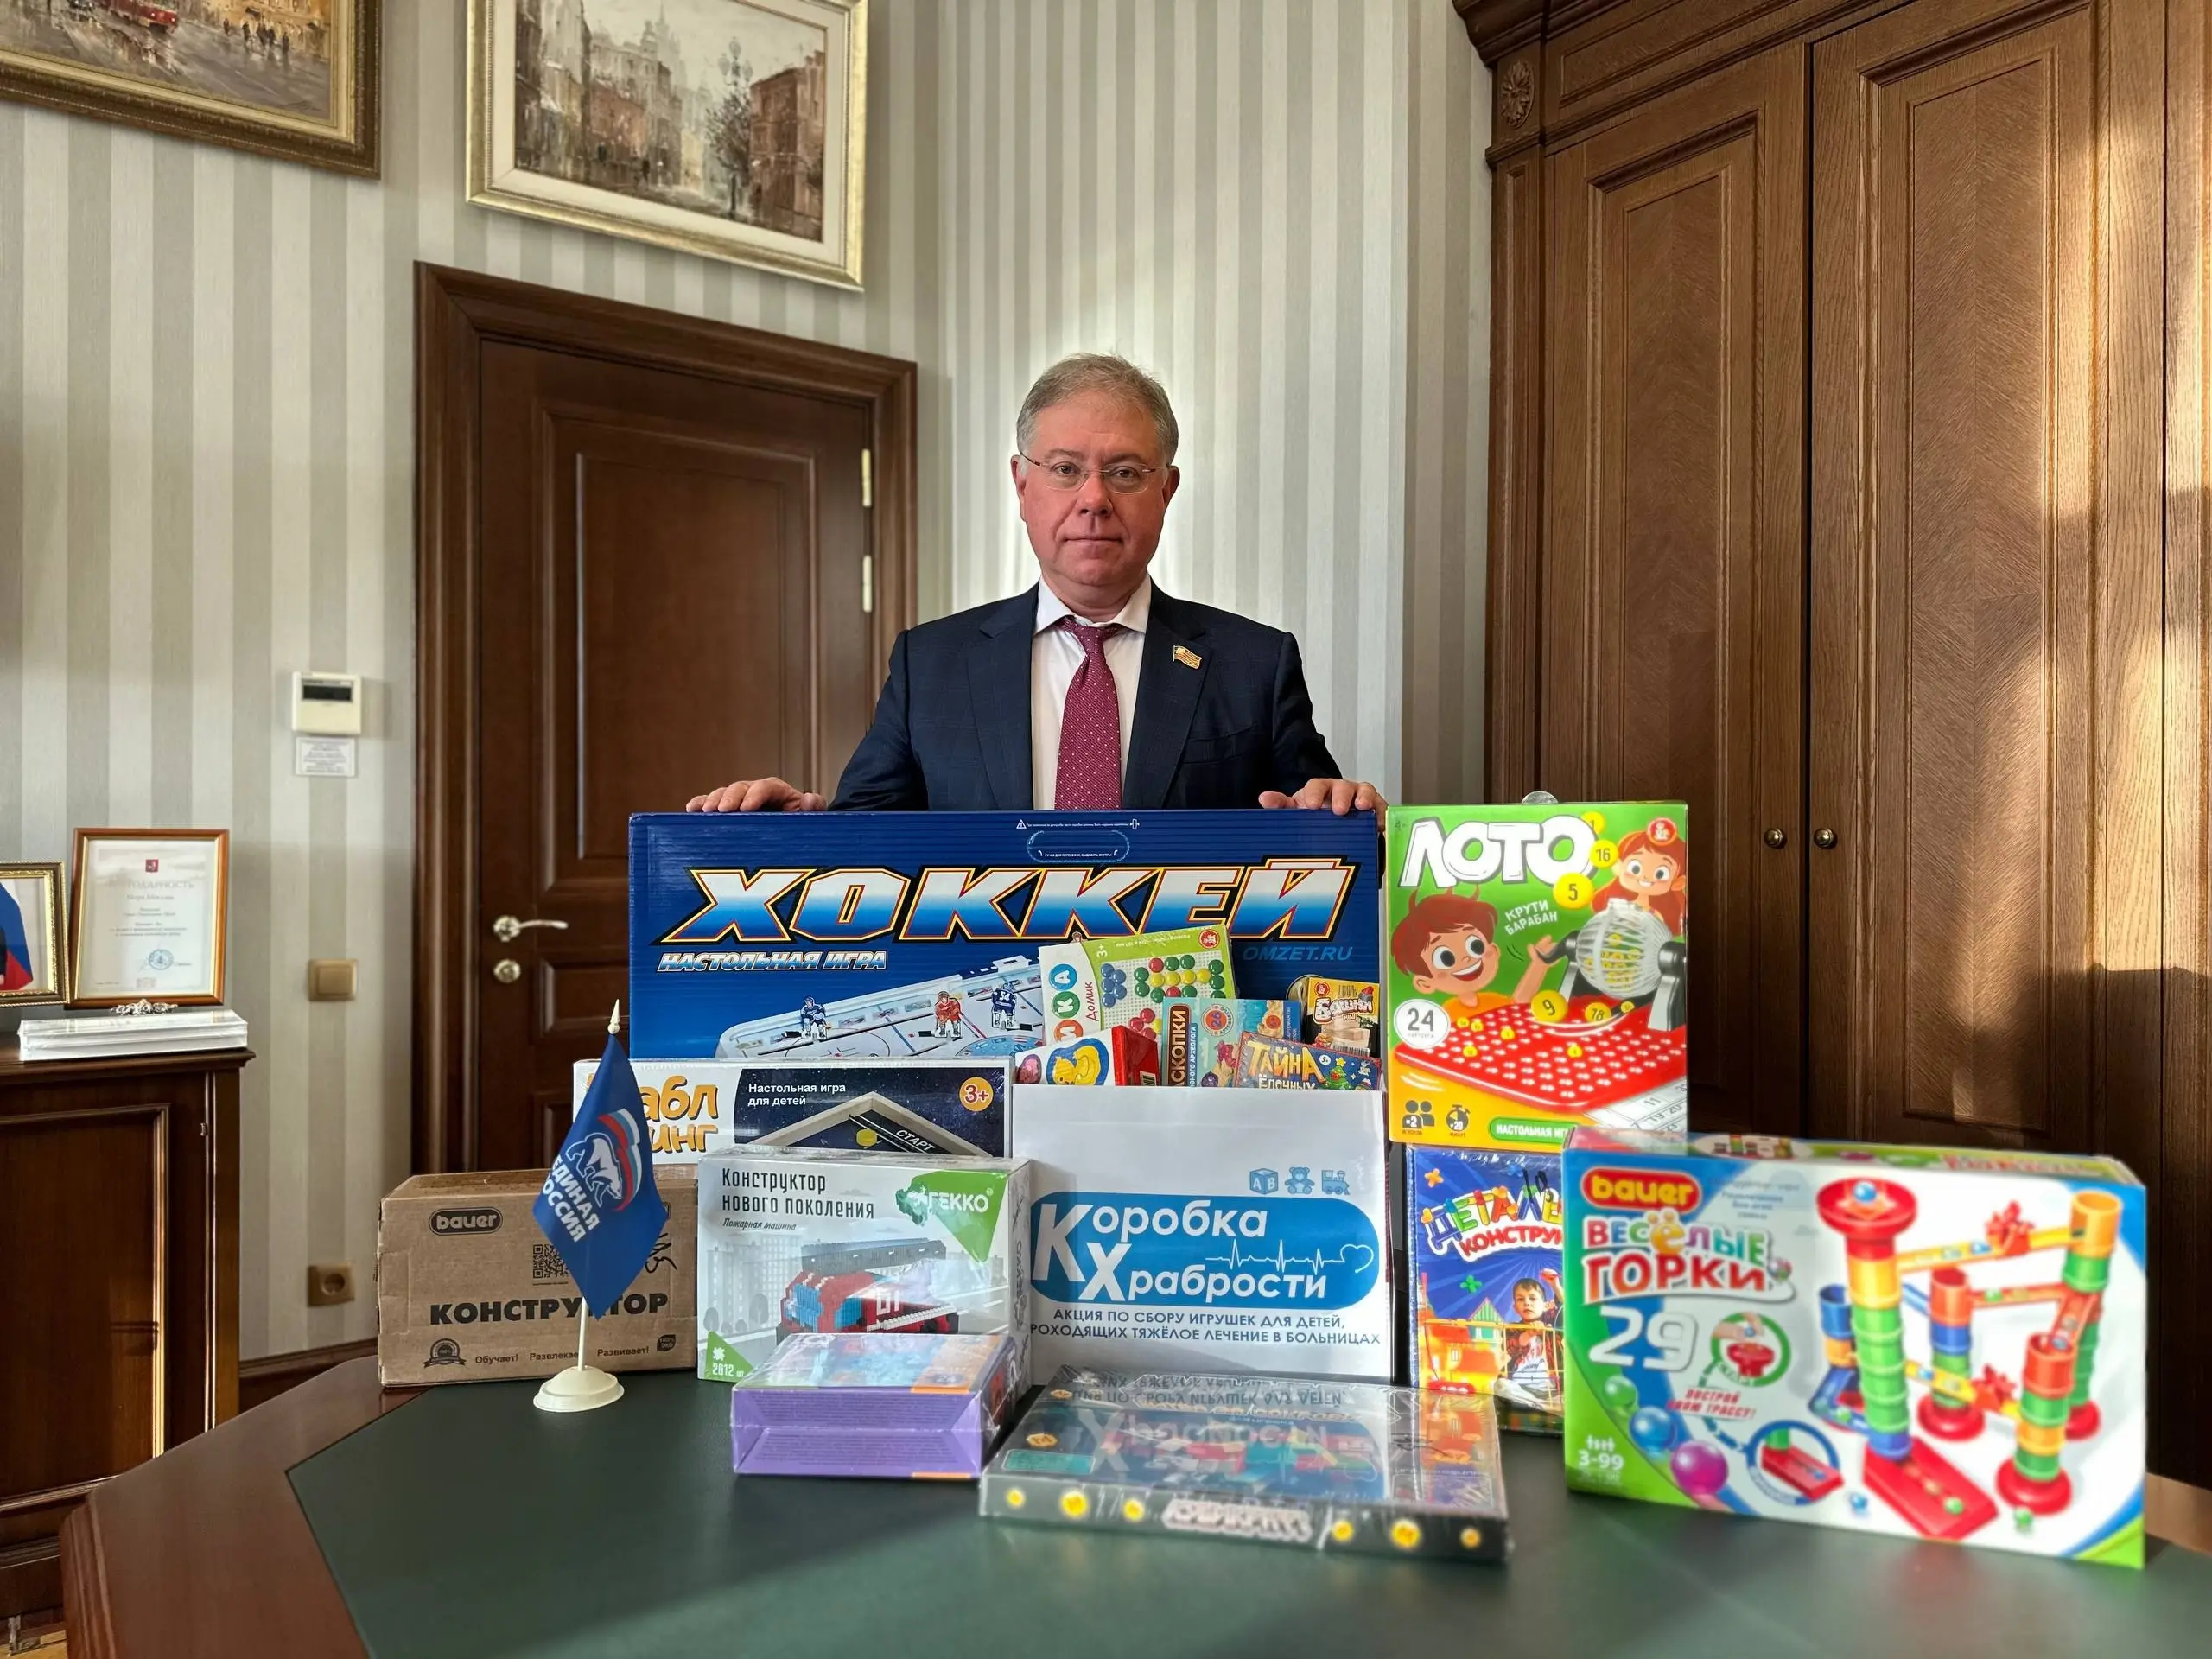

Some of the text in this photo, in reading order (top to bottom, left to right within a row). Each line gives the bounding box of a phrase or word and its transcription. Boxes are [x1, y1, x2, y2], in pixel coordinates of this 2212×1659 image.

[1398, 815, 1598, 888] ЛОТО
[1596, 848, 1611, 862] 16
[659, 857, 1357, 944] ХОККЕЙ
[1567, 883, 1578, 901] 5
[1504, 899, 1549, 922] КРУТИ
[1504, 910, 1558, 936] БАРАБАН
[657, 951, 887, 973] НАСТОЛЬНАЯ ИГРА
[1243, 946, 1353, 962] OMZET.RU
[999, 993, 1010, 1002] 54
[1085, 981, 1100, 1021] Домик
[1542, 999, 1556, 1016] 9
[1315, 997, 1374, 1023] Башни
[1407, 1007, 1434, 1033] 24
[1170, 1010, 1186, 1086] СКОПКИ
[1189, 1026, 1198, 1065] АРХЕОЛОГА
[1246, 1039, 1326, 1084] ТАЙНА
[747, 1083, 846, 1095] Настольная игра
[963, 1086, 989, 1103] 3+
[747, 1096, 806, 1107] для детей
[896, 1128, 936, 1151] СТАРТ
[1496, 1124, 1553, 1138] НАСТОЛЬНАЯ
[552, 1154, 601, 1231] ЕДИНАЯ
[722, 1168, 827, 1194] Конструктор
[1592, 1175, 1693, 1206] bauer
[542, 1173, 587, 1243] ОССИЯ
[722, 1195, 874, 1219] нового поколения
[927, 1191, 989, 1213] ГЕККО
[435, 1212, 498, 1230] bauer
[722, 1217, 797, 1231] Пожарная машина
[1032, 1200, 1268, 1282] Коробка
[1586, 1211, 1769, 1268] ВЕСЁЛЫЕ
[1078, 1242, 1326, 1302] Храбрости
[1586, 1253, 1769, 1303] ГОРКИ
[430, 1292, 669, 1325] КОНСТРУТОР
[1053, 1309, 1345, 1330] АКЦИЯ ПО СБОРУ ИГРУШЕК ДЛЯ ДЕТЕЙ,
[1131, 1324, 1200, 1340] ТЯЖЁЛОЕ
[1205, 1329, 1268, 1342] ЛЕЧЕНИЕ
[1274, 1331, 1281, 1342] В
[1286, 1332, 1381, 1345] БОЛЬНИЦАХ
[1588, 1306, 1699, 1371] 29
[475, 1353, 518, 1364] Обучает!
[596, 1345, 650, 1357] Развивает!
[712, 1363, 734, 1376] 2012
[1685, 1389, 1741, 1404] ПОСТРОЙ
[1578, 1449, 1624, 1470] 3-99
